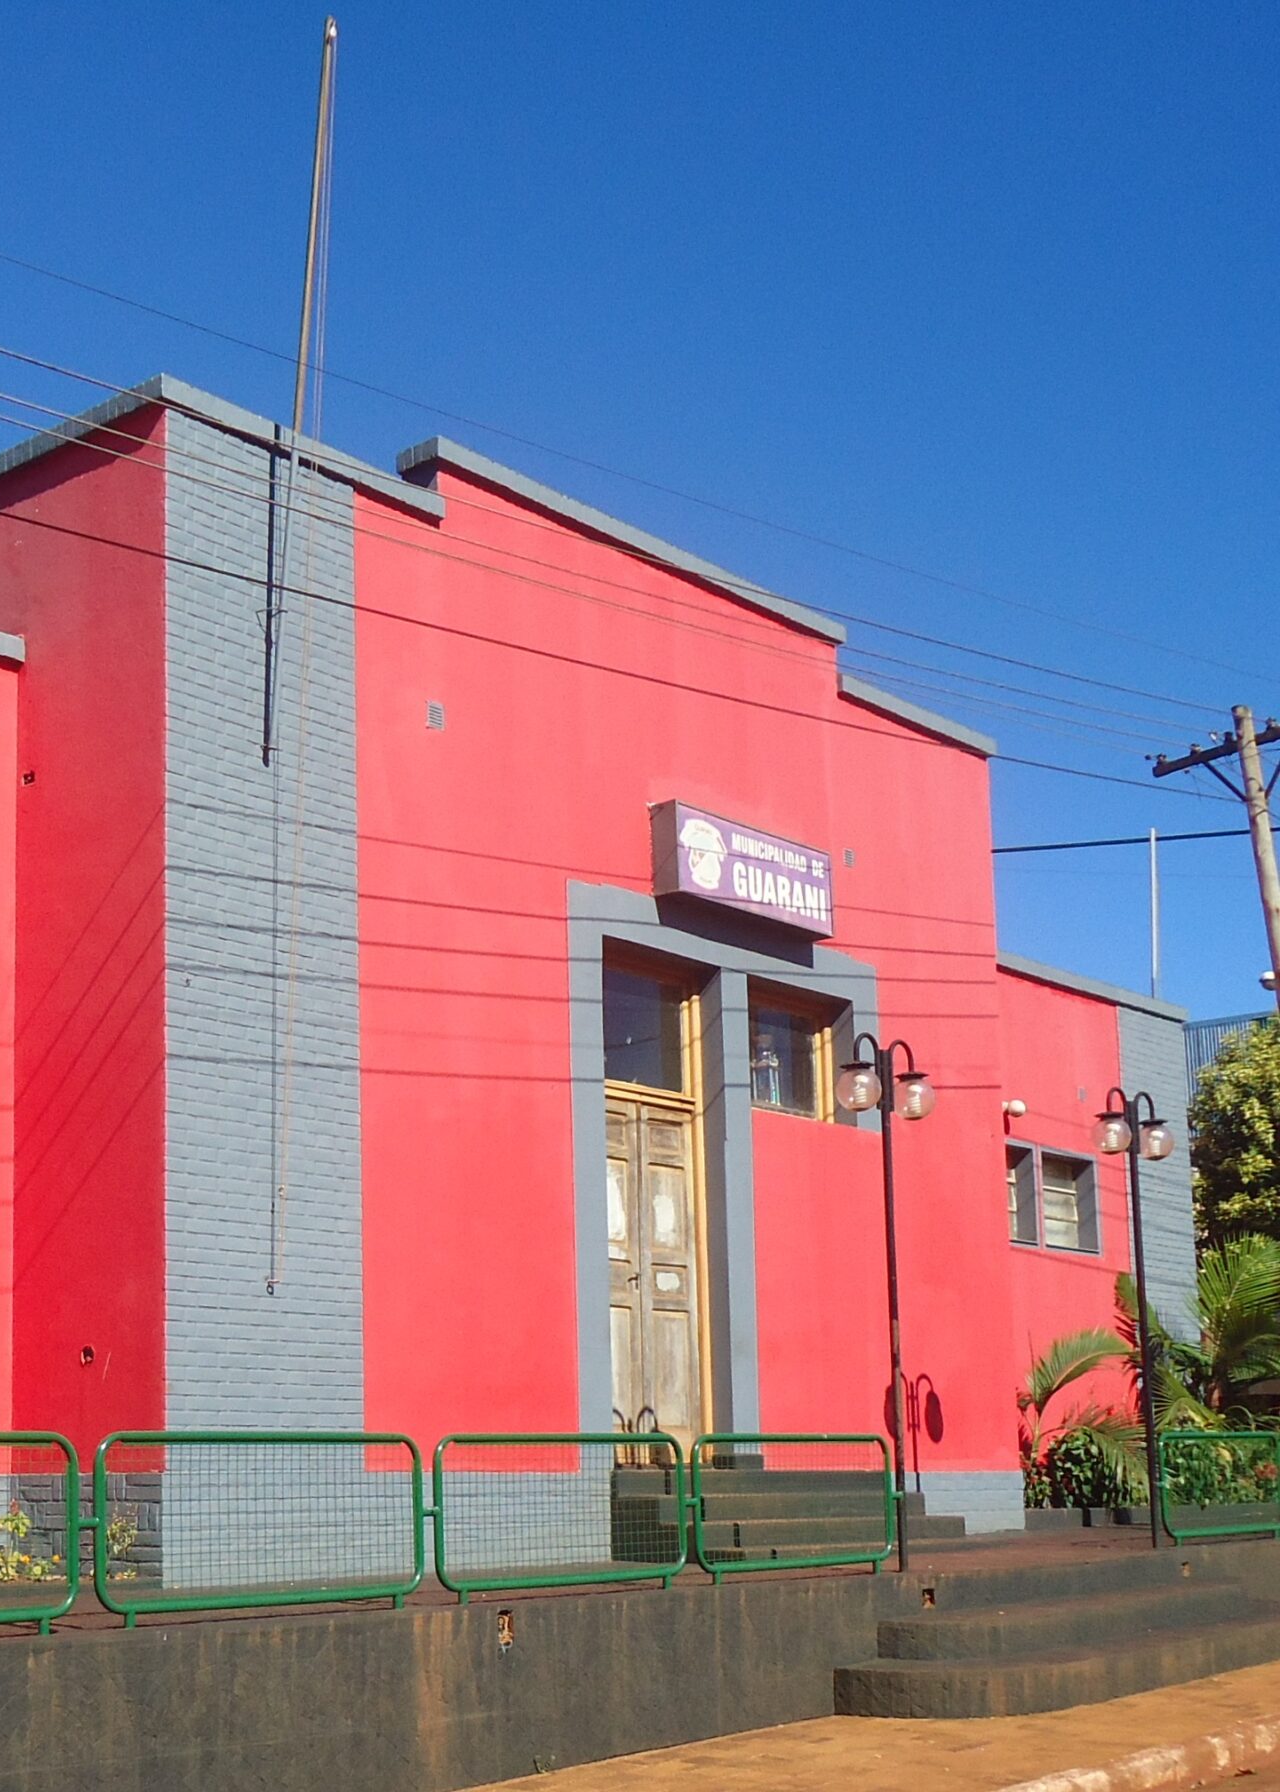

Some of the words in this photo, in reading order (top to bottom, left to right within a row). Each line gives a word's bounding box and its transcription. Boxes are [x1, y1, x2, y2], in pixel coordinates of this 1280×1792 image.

[732, 833, 807, 872] MUNICIPALIDAD
[811, 860, 825, 878] DE
[733, 862, 826, 921] GUARANI
